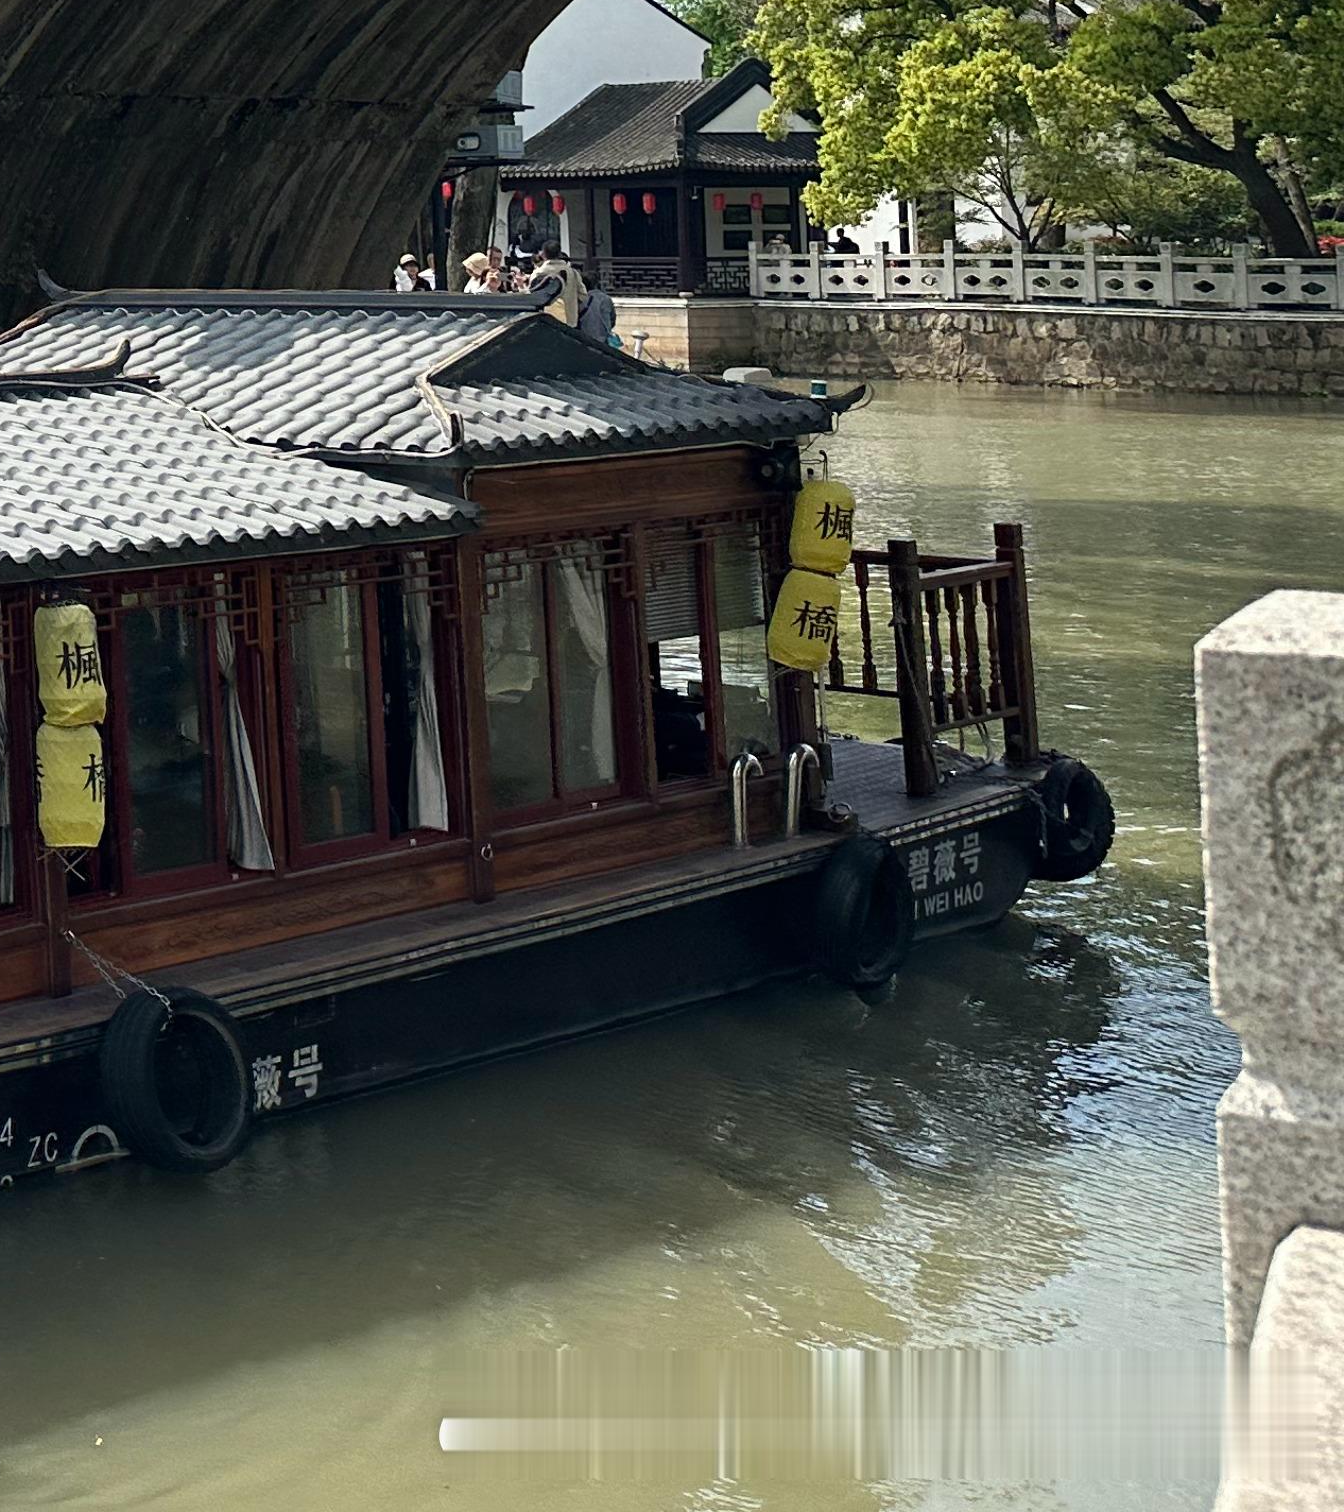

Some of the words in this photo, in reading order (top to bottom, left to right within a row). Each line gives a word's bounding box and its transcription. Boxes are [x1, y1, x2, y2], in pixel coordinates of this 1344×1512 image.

[908, 832, 982, 892] 碧薇号
[924, 891, 950, 917] WEI
[954, 880, 984, 908] HAO
[27, 1132, 59, 1168] ZC
